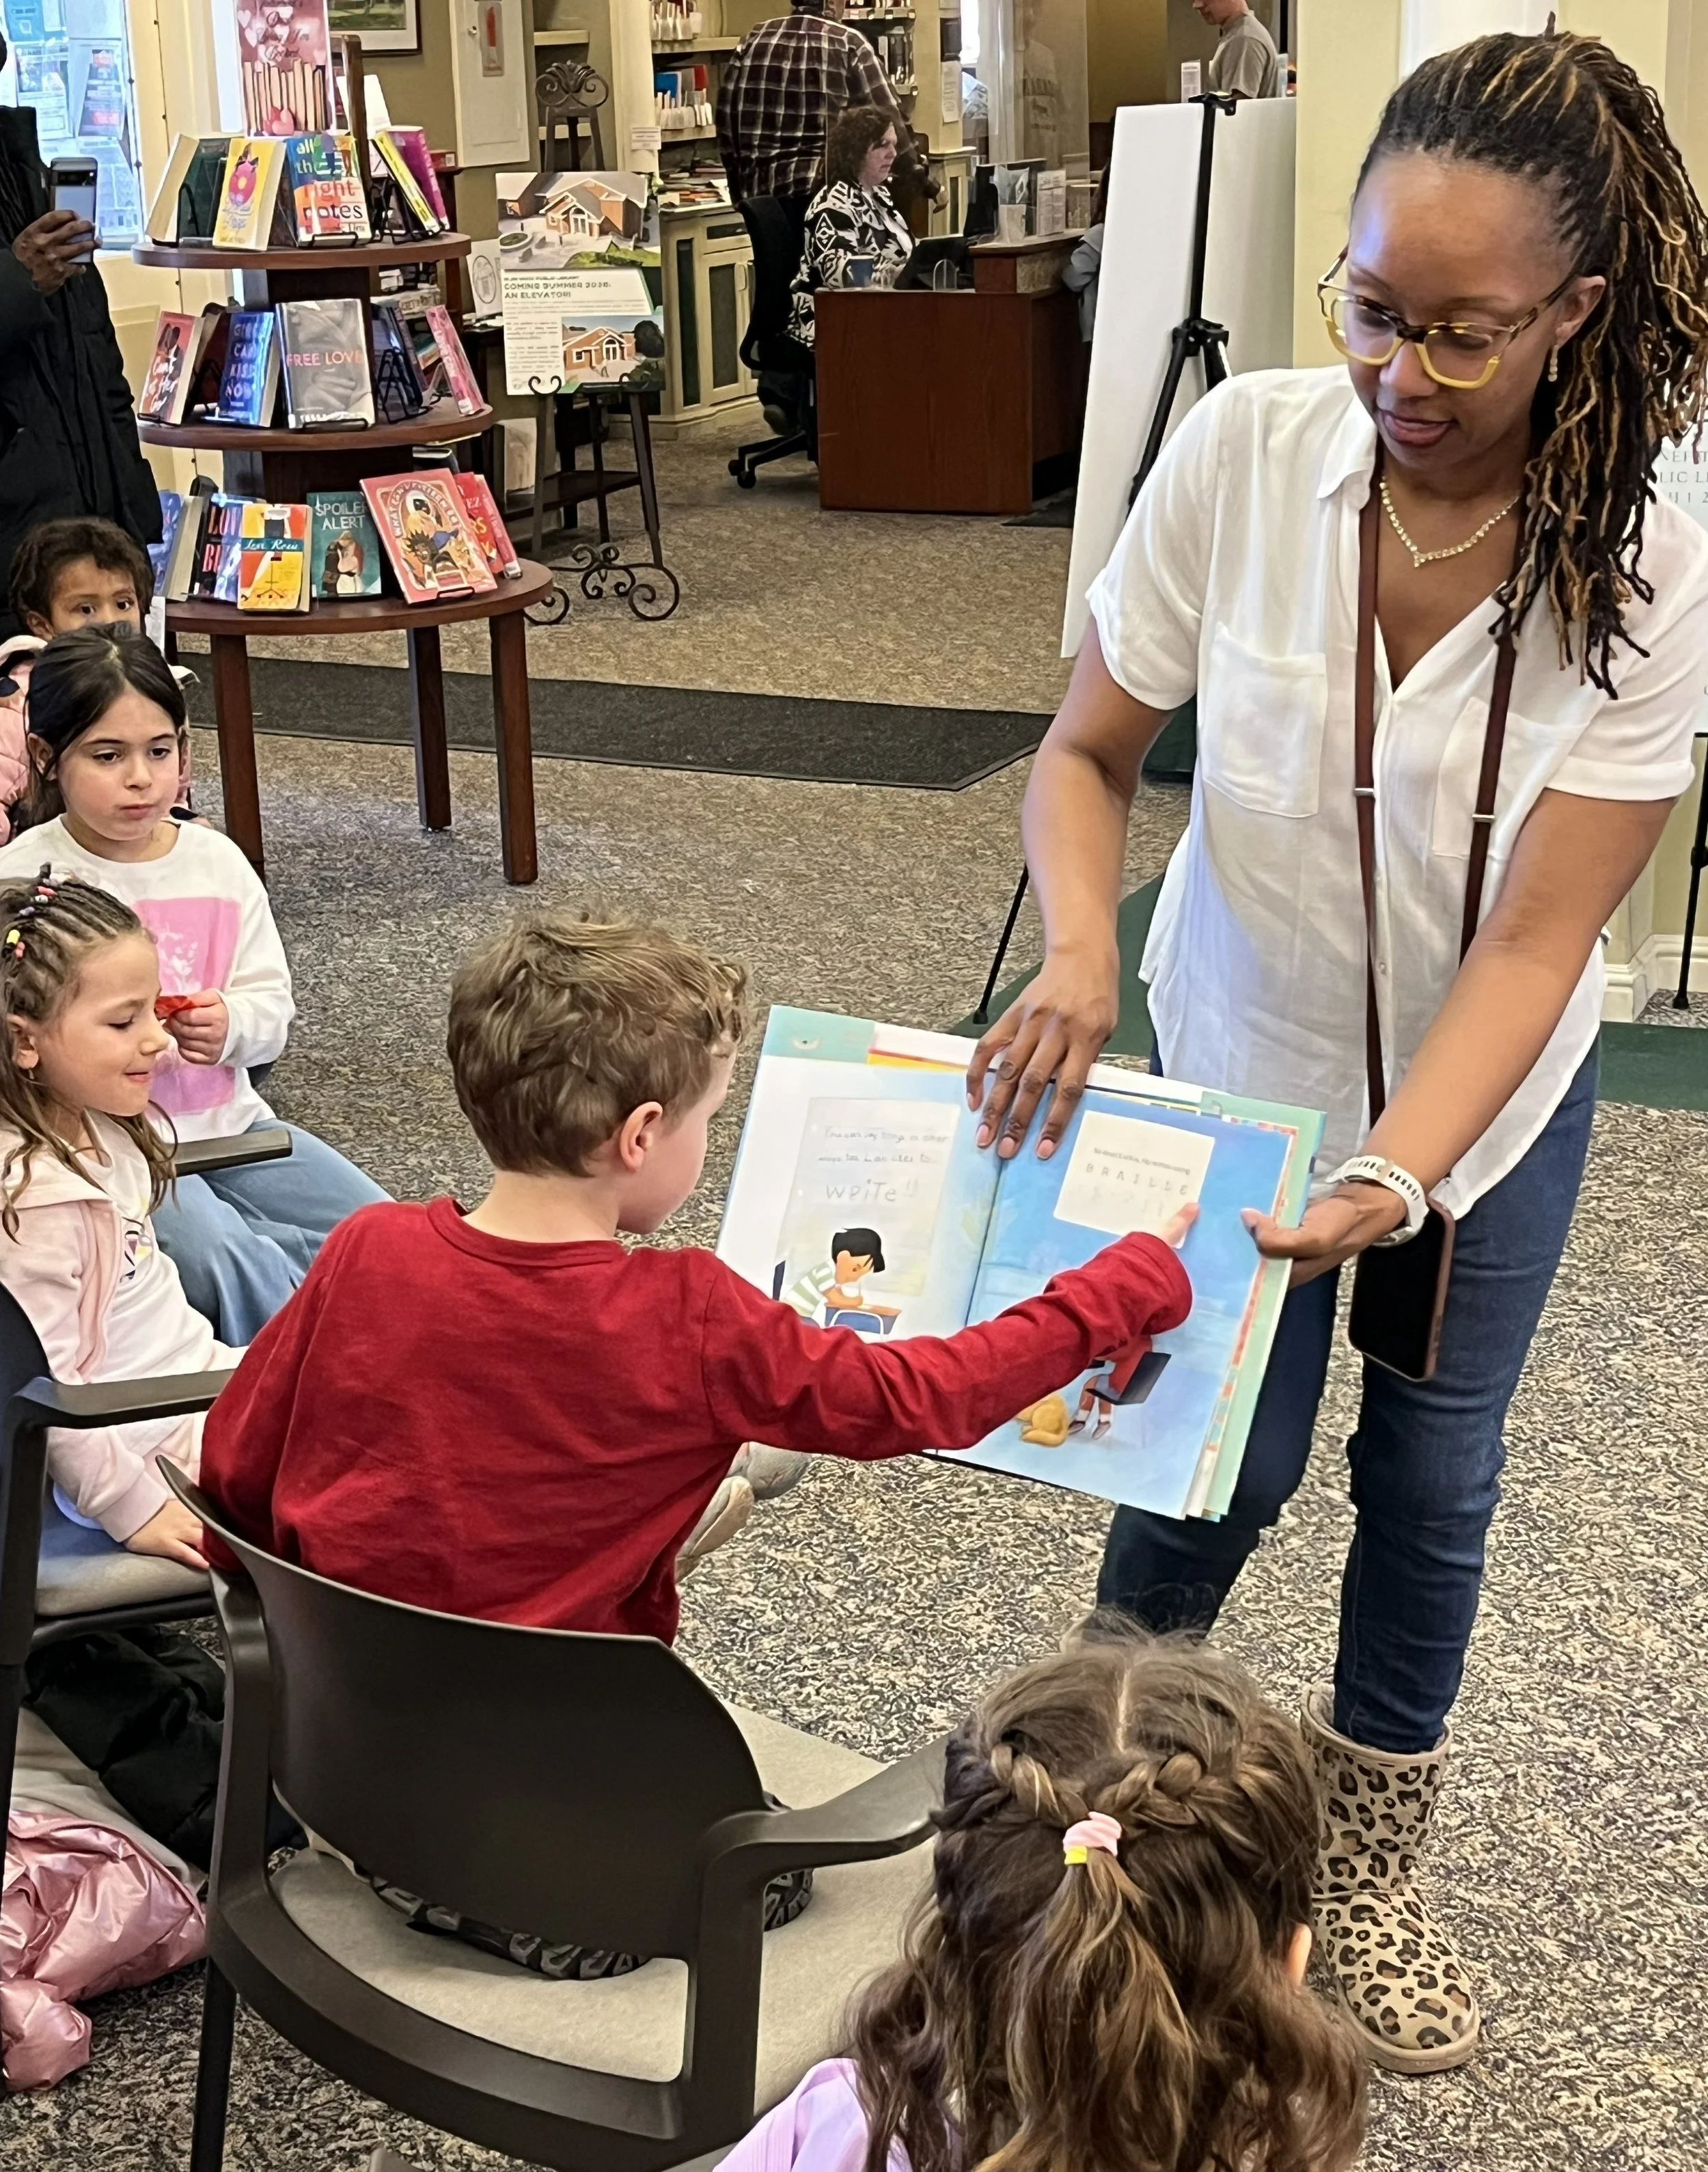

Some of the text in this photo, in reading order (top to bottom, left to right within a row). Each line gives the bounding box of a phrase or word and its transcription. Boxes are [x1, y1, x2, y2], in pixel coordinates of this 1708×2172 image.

[297, 138, 314, 154] all
[304, 180, 355, 201] right
[303, 204, 363, 221] notes
[286, 349, 364, 367] FREE LOVE
[207, 504, 245, 536] LOV
[322, 514, 366, 531] ALERT
